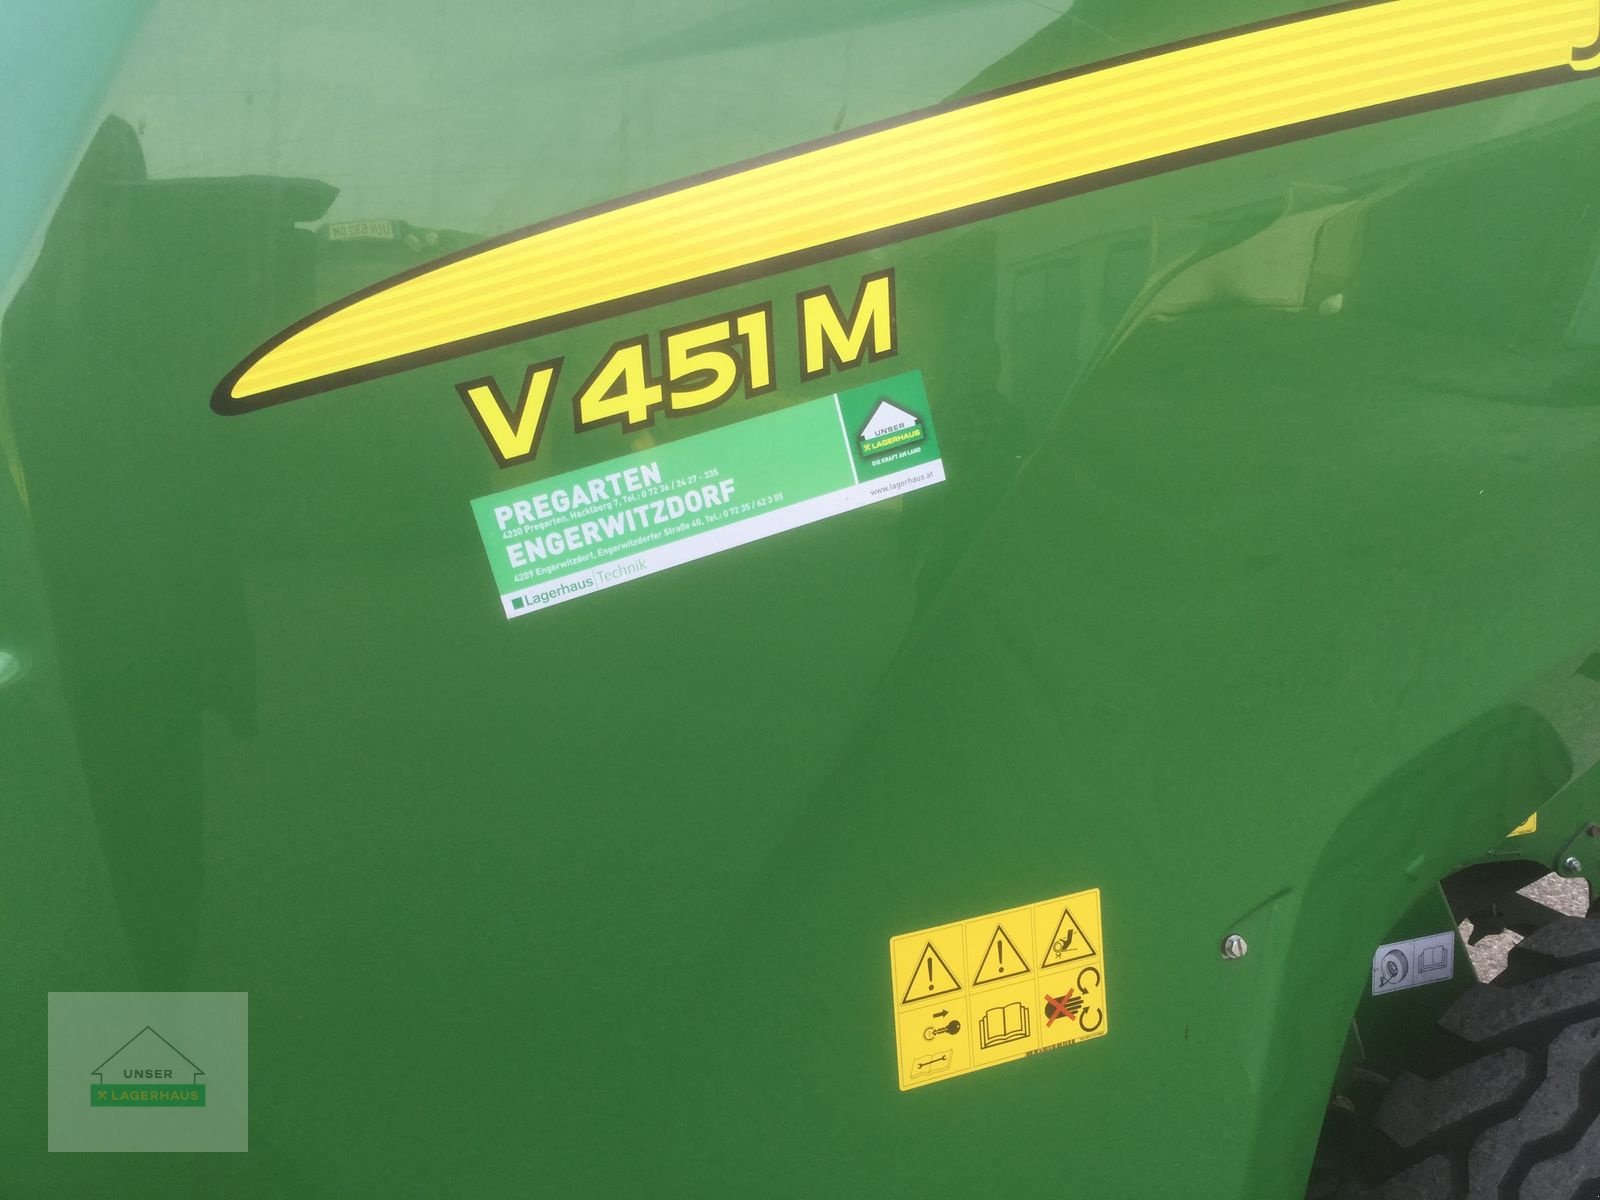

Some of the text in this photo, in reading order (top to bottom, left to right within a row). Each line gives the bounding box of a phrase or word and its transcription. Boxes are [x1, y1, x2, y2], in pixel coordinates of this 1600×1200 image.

[461, 272, 894, 464] V 451 M
[871, 429, 921, 449] LAGERHAUS
[874, 422, 905, 437] UNSER
[494, 461, 663, 531] PREGARTEN
[502, 527, 523, 540] 4230
[704, 468, 719, 479] 335
[870, 471, 934, 496] www.lagerhaus.at
[506, 478, 736, 569] ENGERWITZDORF
[514, 569, 534, 583] 4209
[599, 532, 662, 558] Engerwitzdorfer
[663, 523, 690, 537] Straße
[524, 558, 648, 607] Lagerhaus Technik
